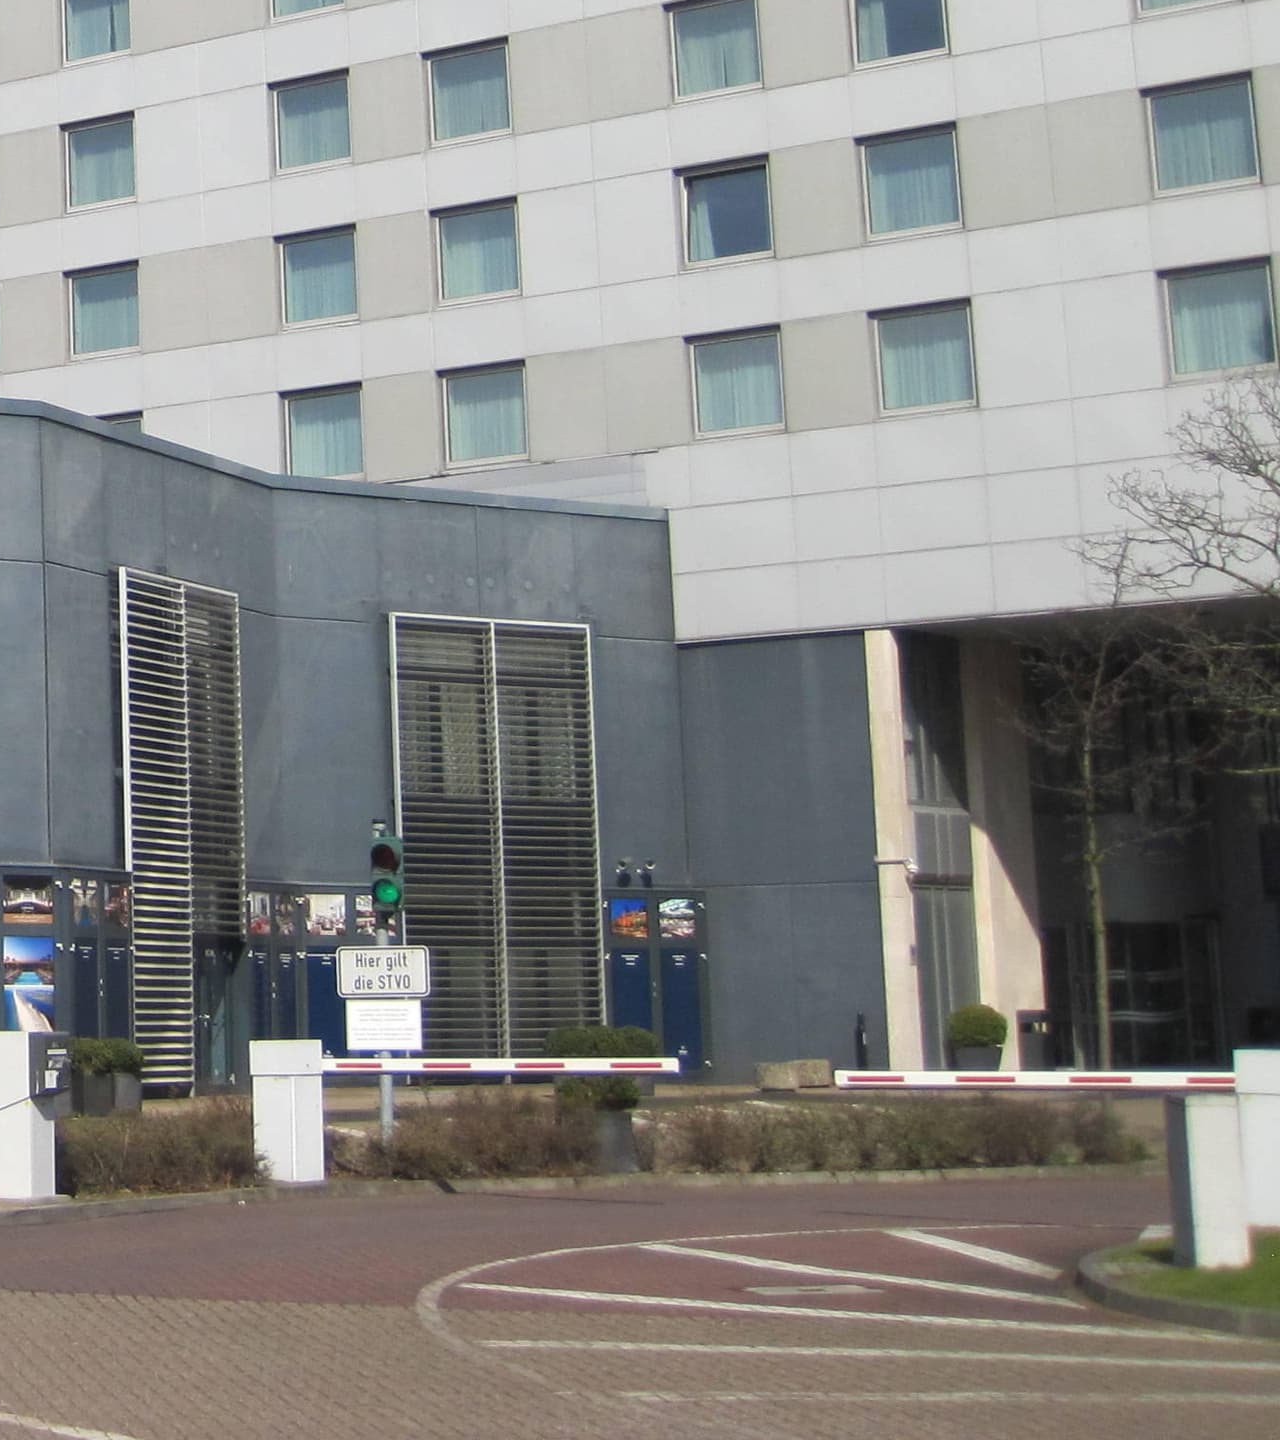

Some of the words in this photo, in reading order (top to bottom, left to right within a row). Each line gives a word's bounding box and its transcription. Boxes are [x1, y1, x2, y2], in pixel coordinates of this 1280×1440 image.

[355, 953, 381, 968] Hier
[386, 953, 407, 971] gilt
[354, 975, 373, 990] die
[378, 974, 411, 989] STVO
